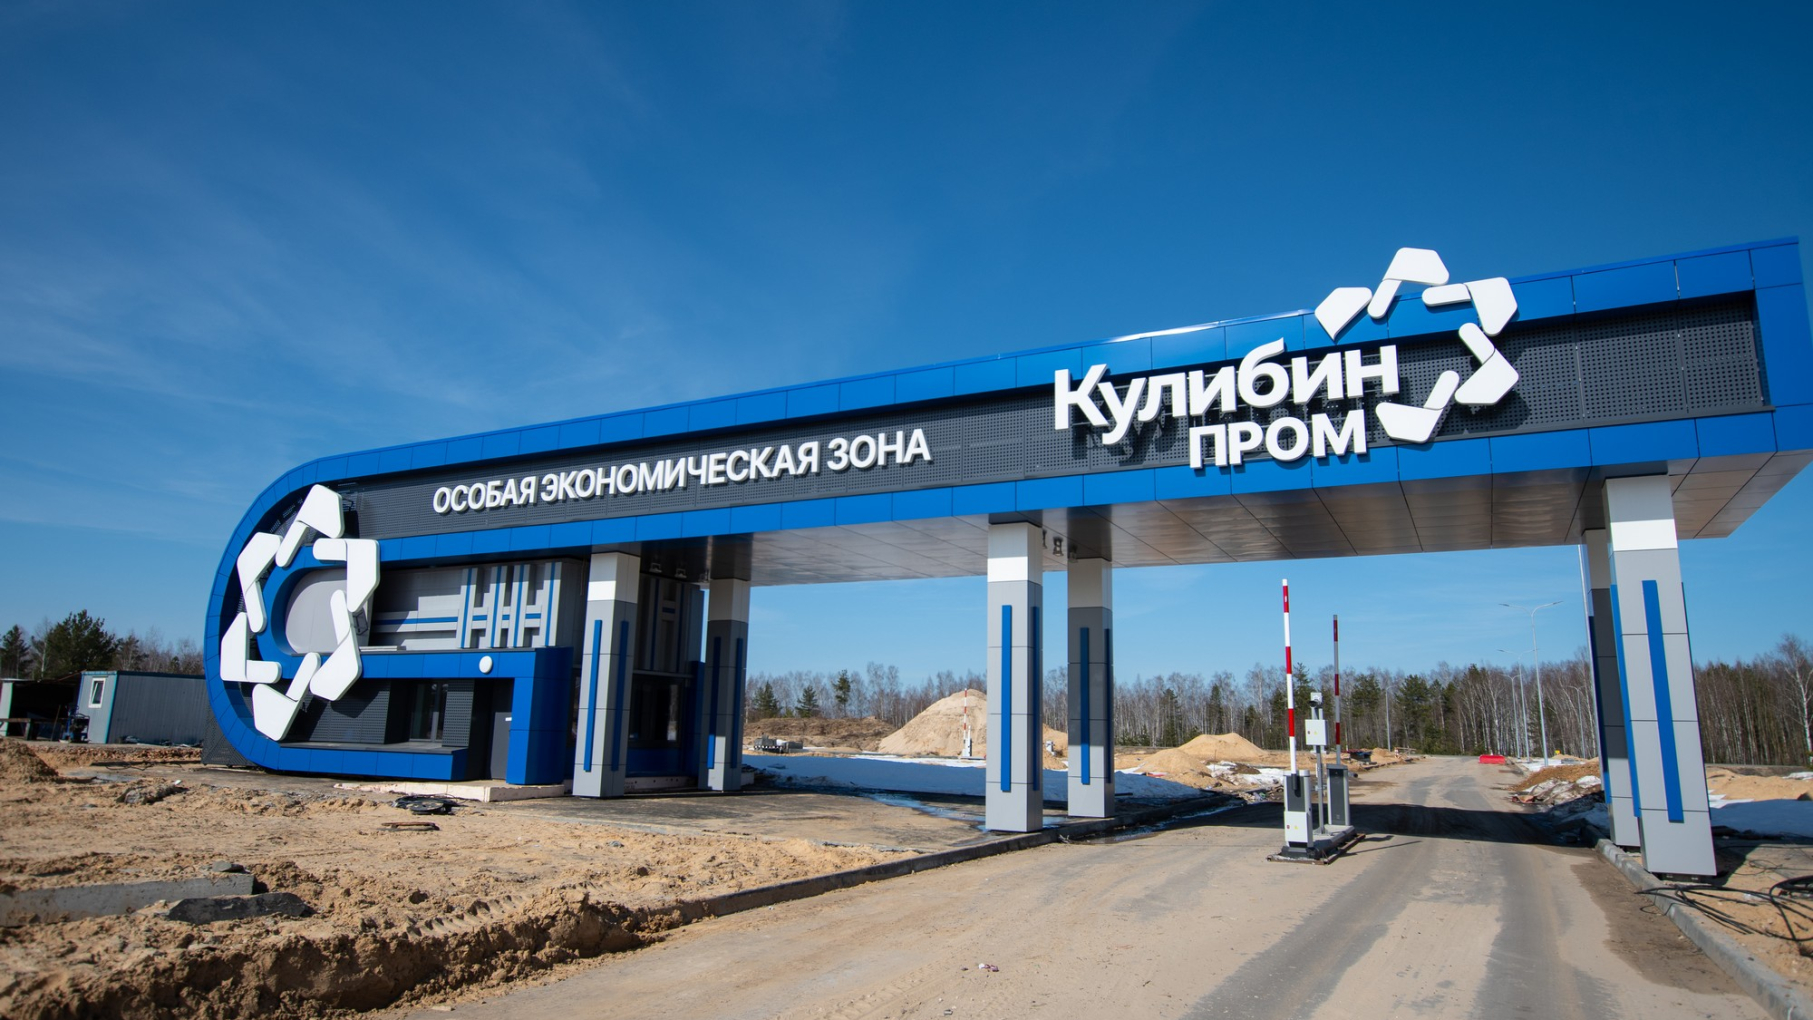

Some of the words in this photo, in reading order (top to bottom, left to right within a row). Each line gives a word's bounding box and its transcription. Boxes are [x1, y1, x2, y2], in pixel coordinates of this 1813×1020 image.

[1054, 337, 1400, 446] Кулибин
[433, 476, 537, 513] ОСОБАЯ
[541, 441, 819, 502] ЭКОНОМИЧЕСКАЯ
[827, 428, 932, 470] ЗОНА
[1189, 410, 1367, 469] ПРОМ
